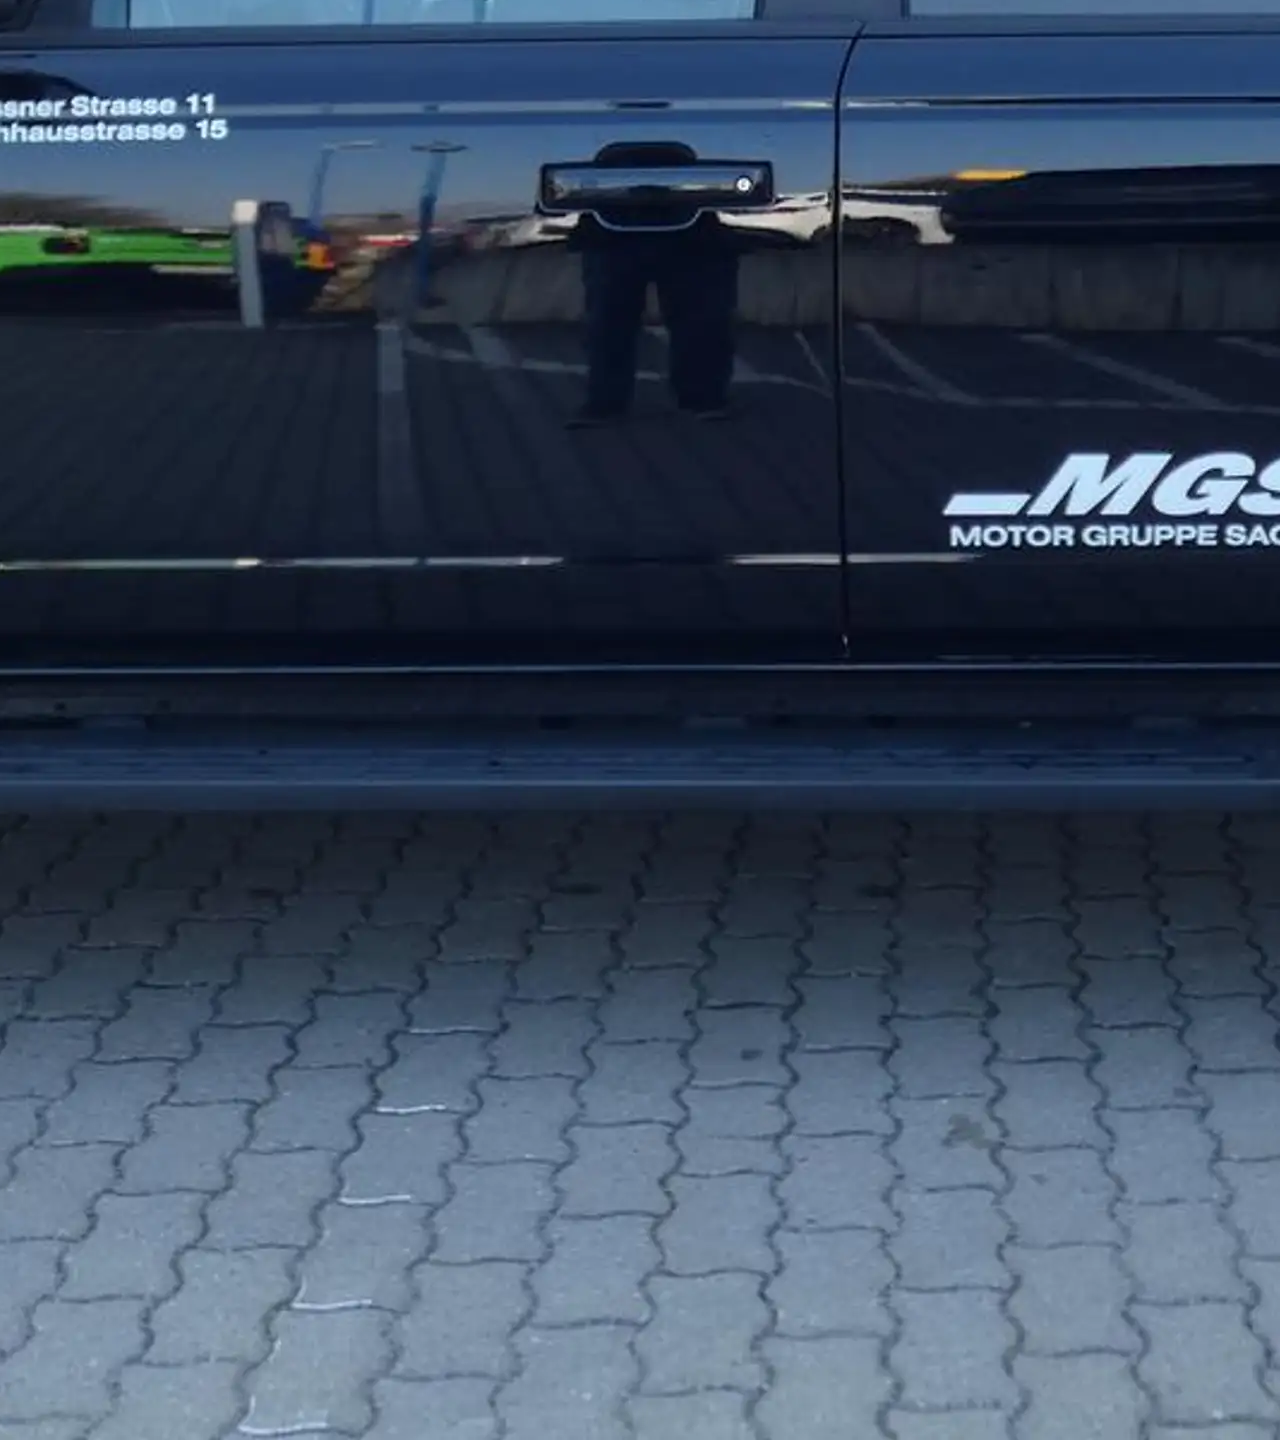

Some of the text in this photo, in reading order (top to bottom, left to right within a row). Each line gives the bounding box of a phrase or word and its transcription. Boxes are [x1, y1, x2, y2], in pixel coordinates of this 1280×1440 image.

[70, 94, 177, 117] Strasse
[186, 92, 216, 114] 11
[195, 119, 228, 140] 15
[950, 525, 1074, 548] MOTOR
[1081, 524, 1218, 547] GRUPPE
